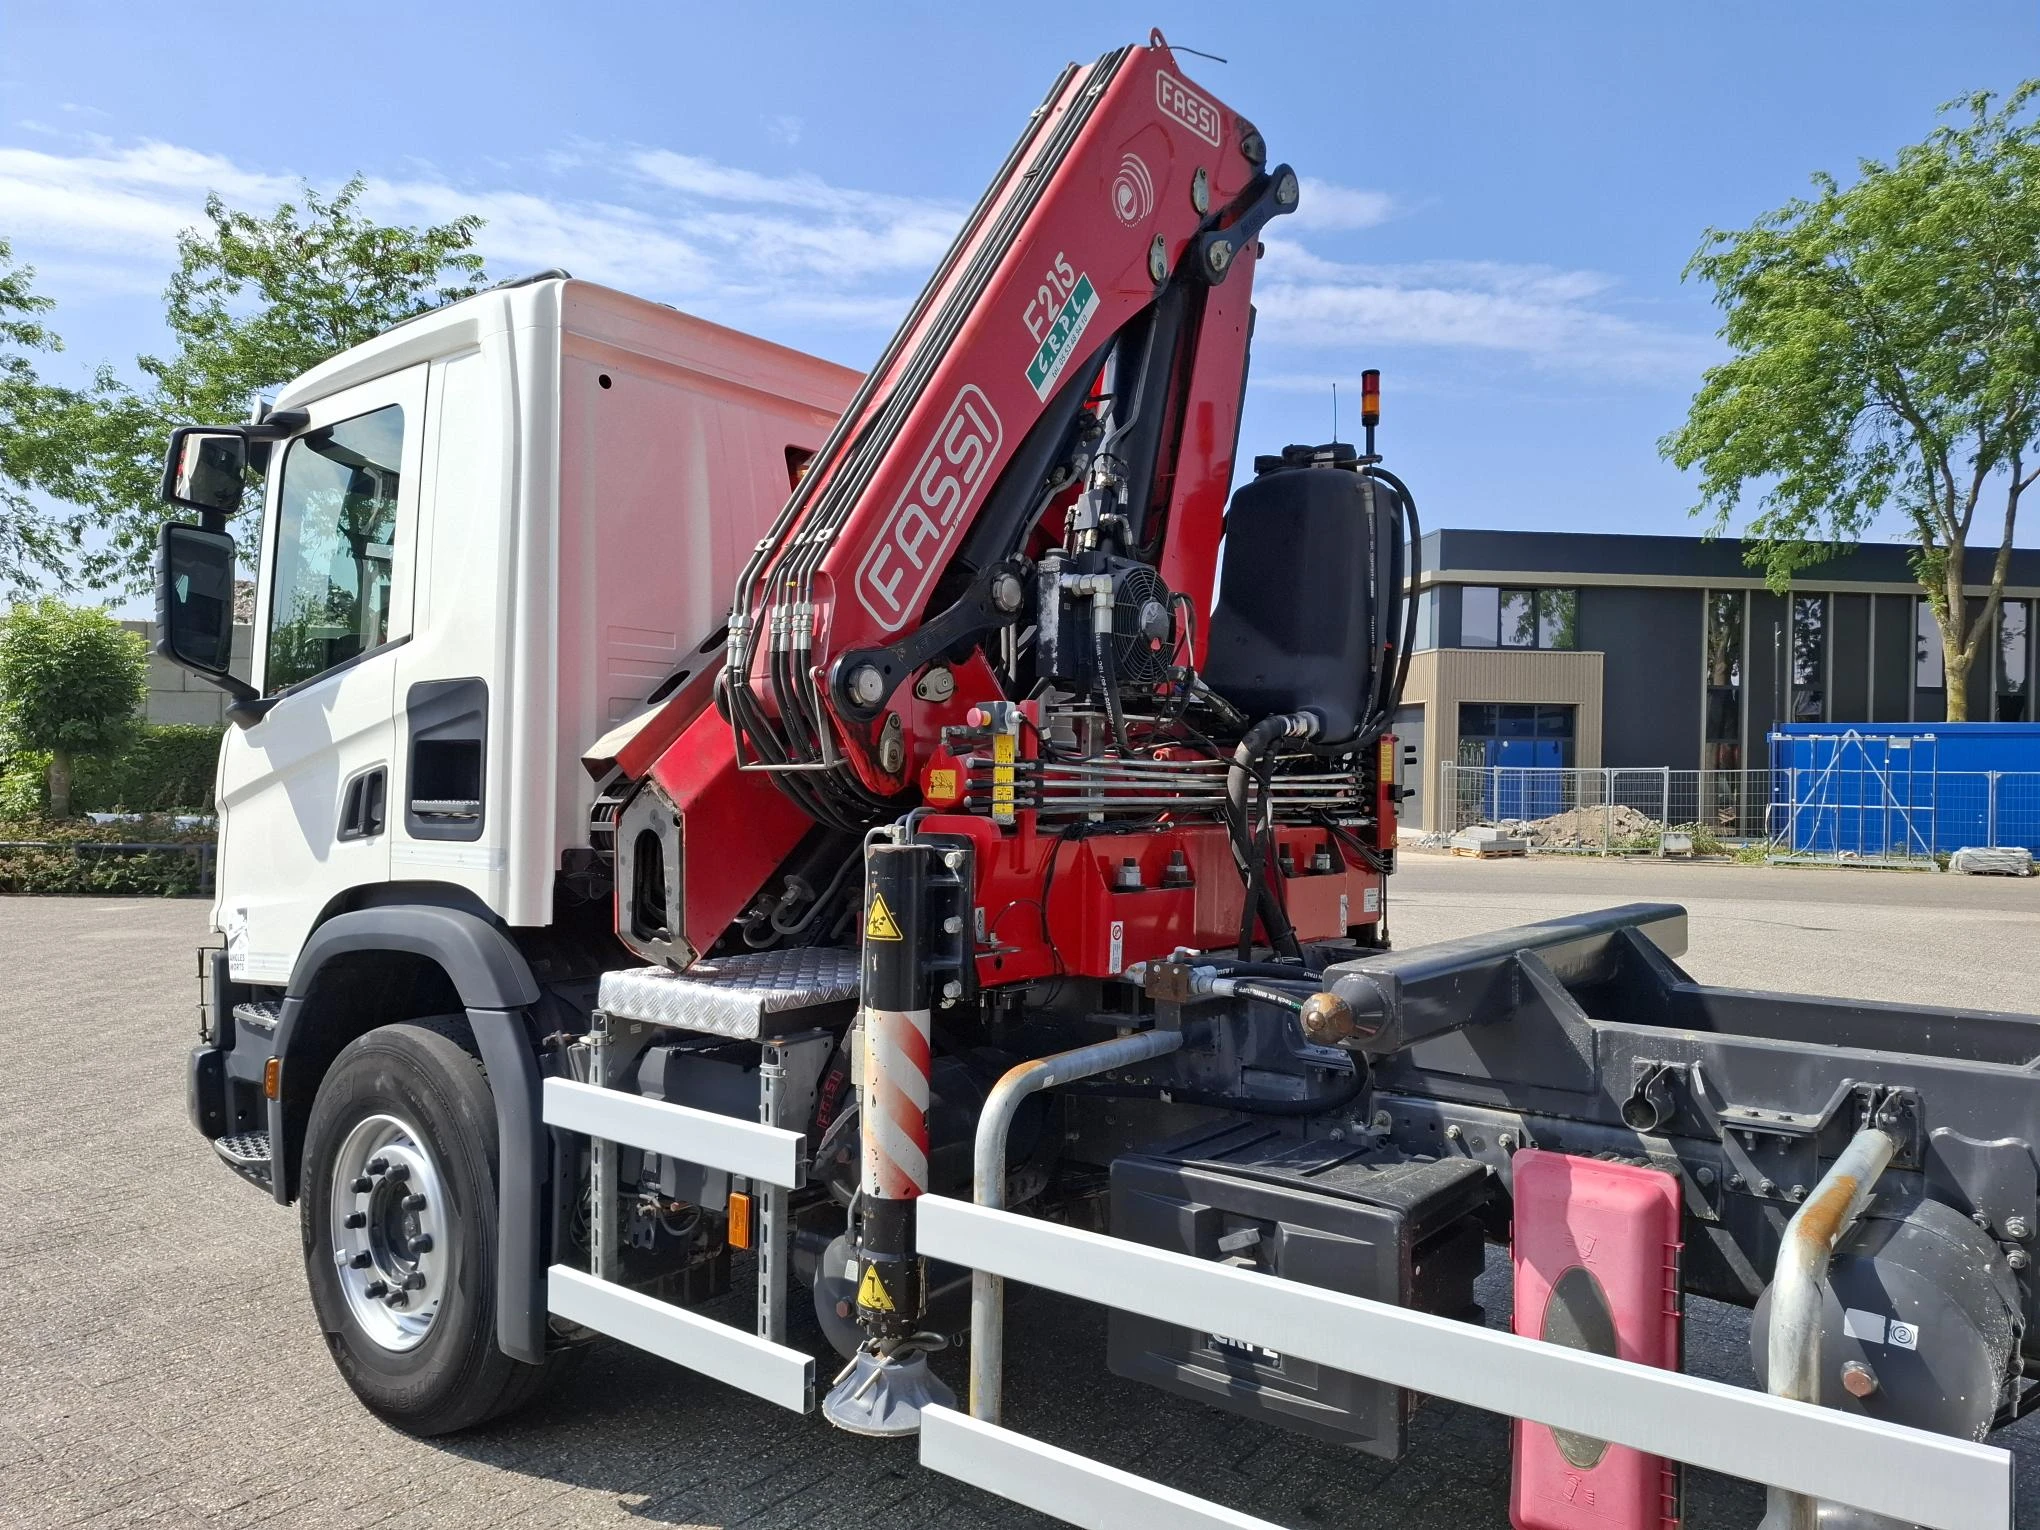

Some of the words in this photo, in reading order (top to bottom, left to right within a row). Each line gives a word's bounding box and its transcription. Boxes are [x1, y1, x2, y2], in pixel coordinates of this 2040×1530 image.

[1162, 79, 1215, 137] FASSI
[1022, 251, 1075, 344] F215
[868, 402, 993, 611] FASSI
[1898, 1329, 1907, 1340] 2
